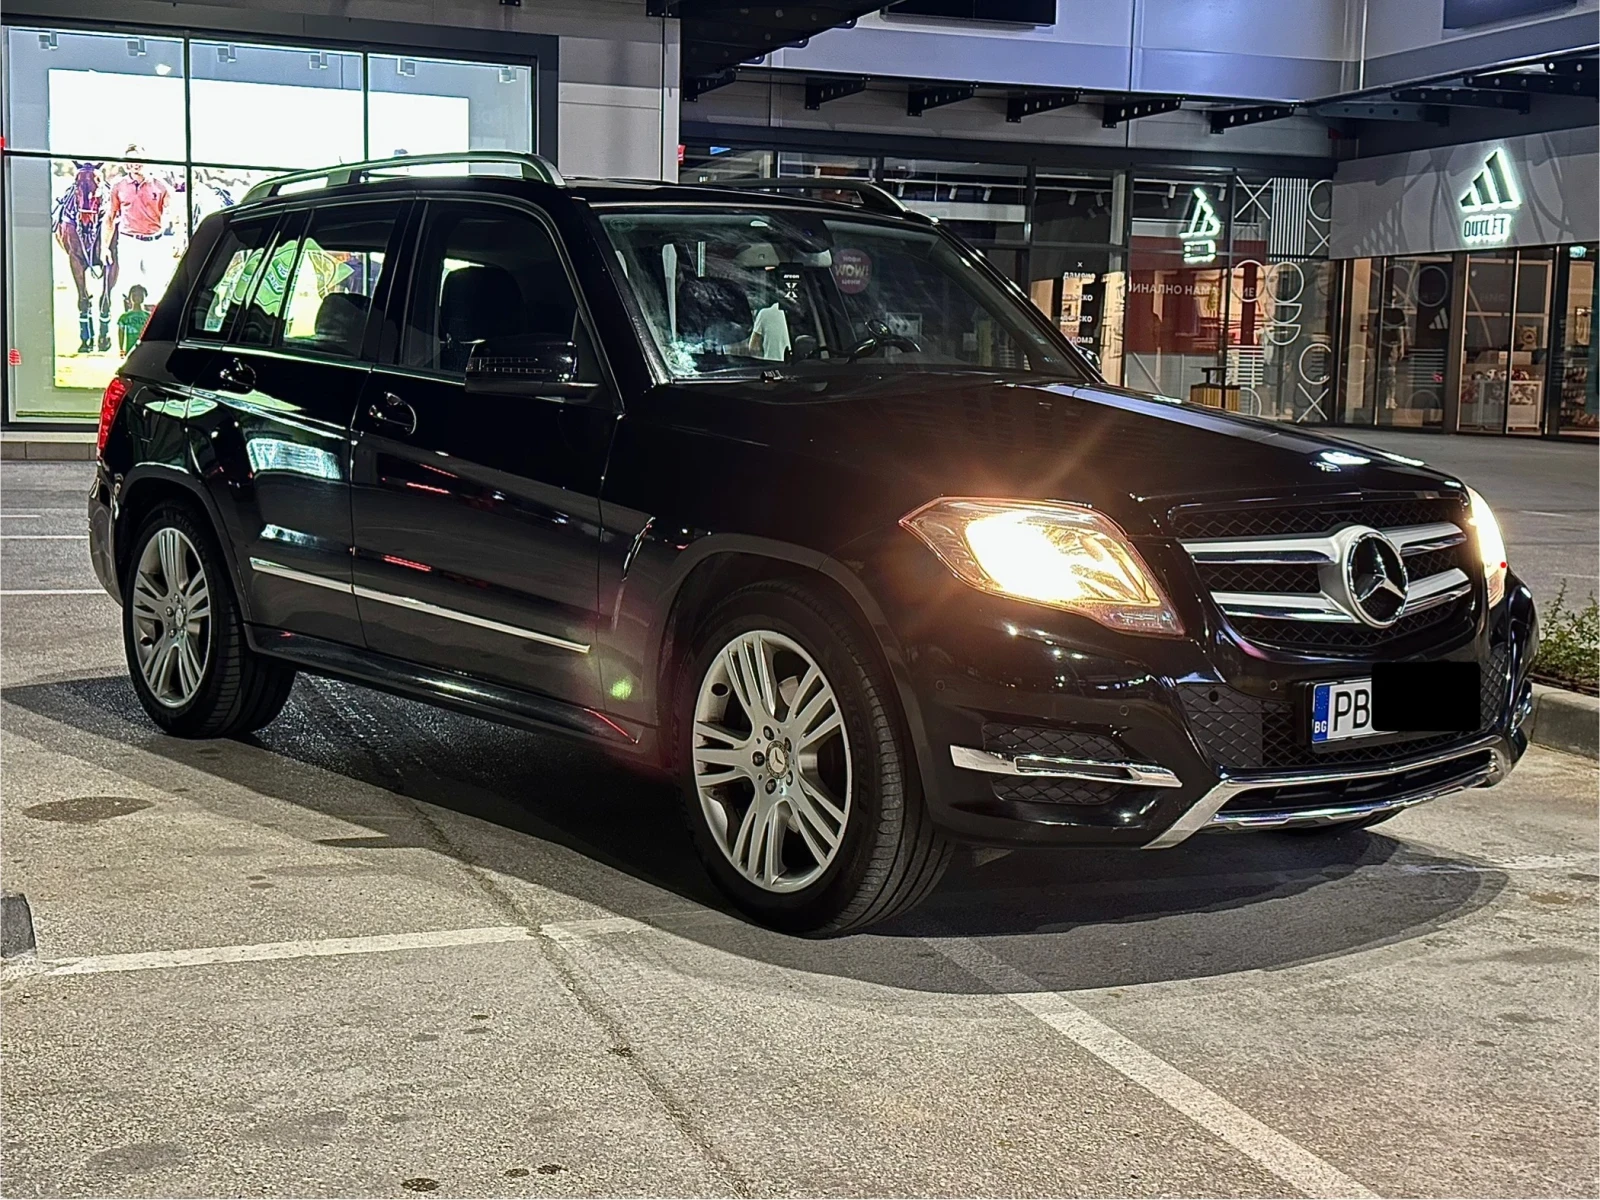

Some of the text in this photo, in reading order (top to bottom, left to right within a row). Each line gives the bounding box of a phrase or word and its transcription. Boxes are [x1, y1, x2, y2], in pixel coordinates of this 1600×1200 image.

[1464, 218, 1506, 237] OUTLET
[834, 264, 869, 278] WOW!
[1129, 281, 1182, 295] ИНАЛНО
[1333, 689, 1371, 732] PB
[1314, 720, 1328, 734] BG
